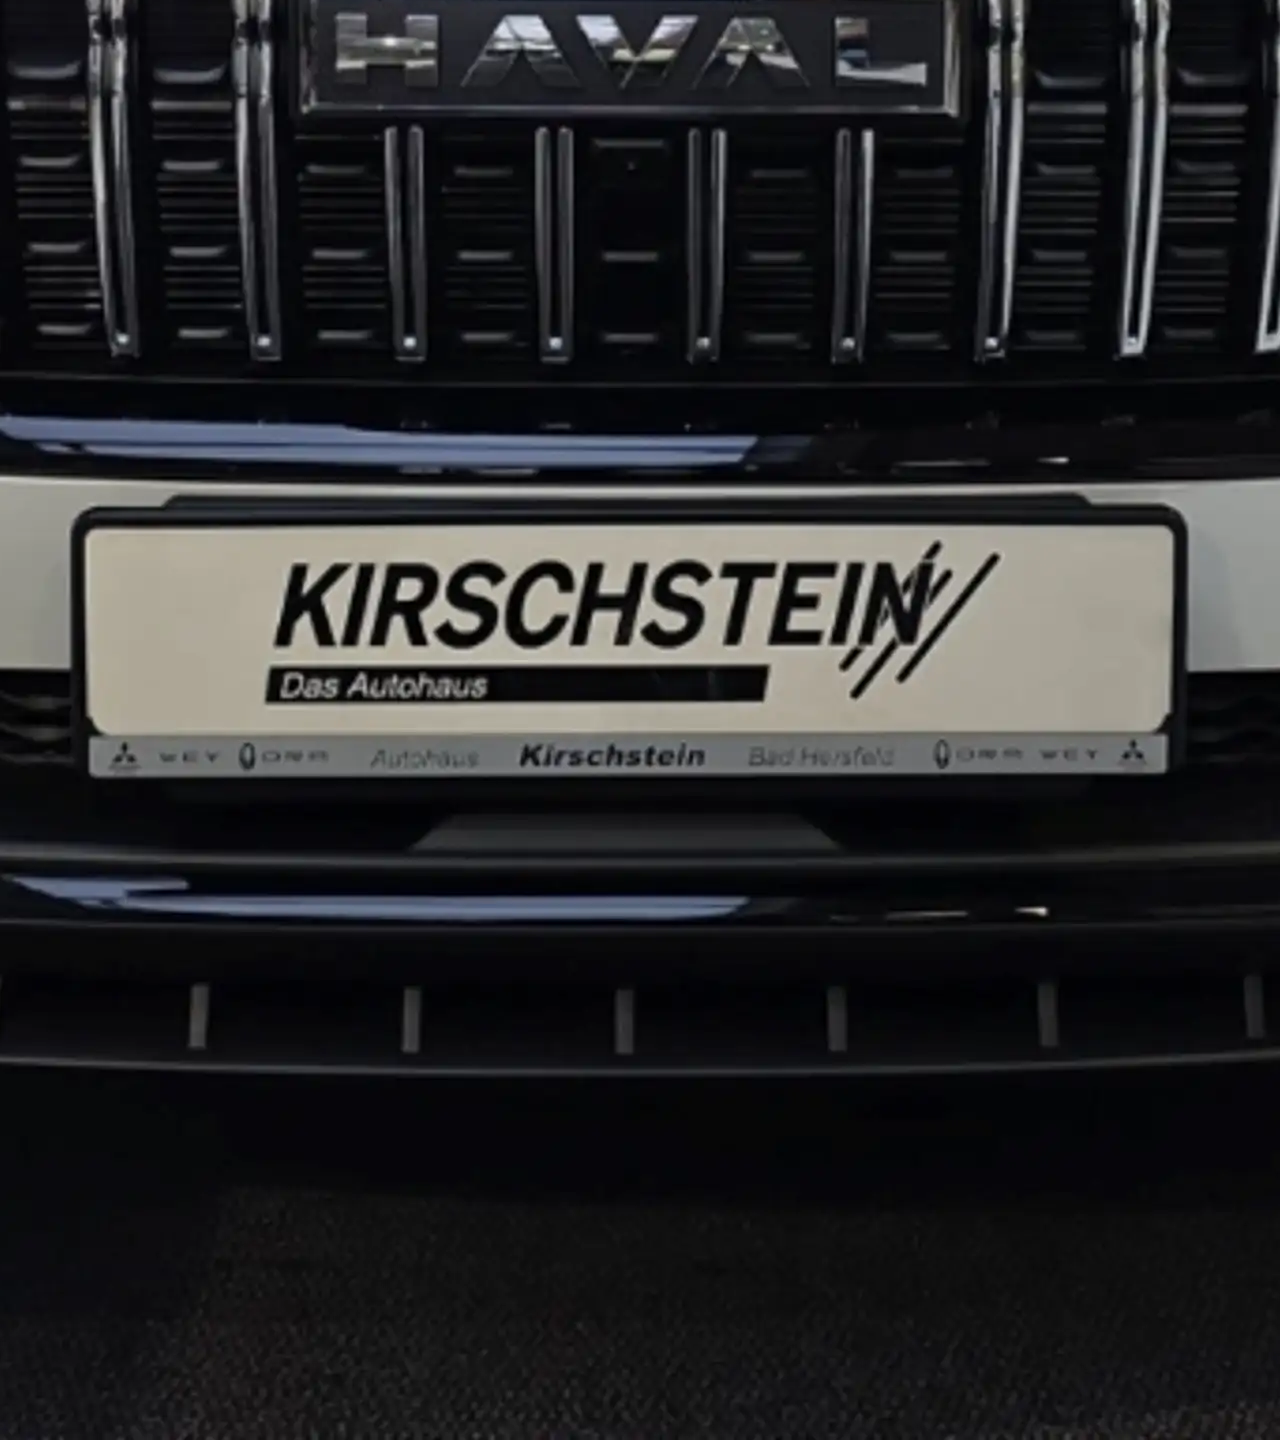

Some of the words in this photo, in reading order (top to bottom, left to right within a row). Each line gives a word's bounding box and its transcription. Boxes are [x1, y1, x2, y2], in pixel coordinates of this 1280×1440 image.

[335, 13, 928, 88] HAVAL
[273, 559, 934, 650] KIRSCHSTEIN
[279, 671, 339, 699] Das
[346, 671, 489, 700] Autohaus
[370, 749, 480, 769] Autohaus
[519, 742, 706, 768] Kirschstein
[748, 746, 793, 767] Bad
